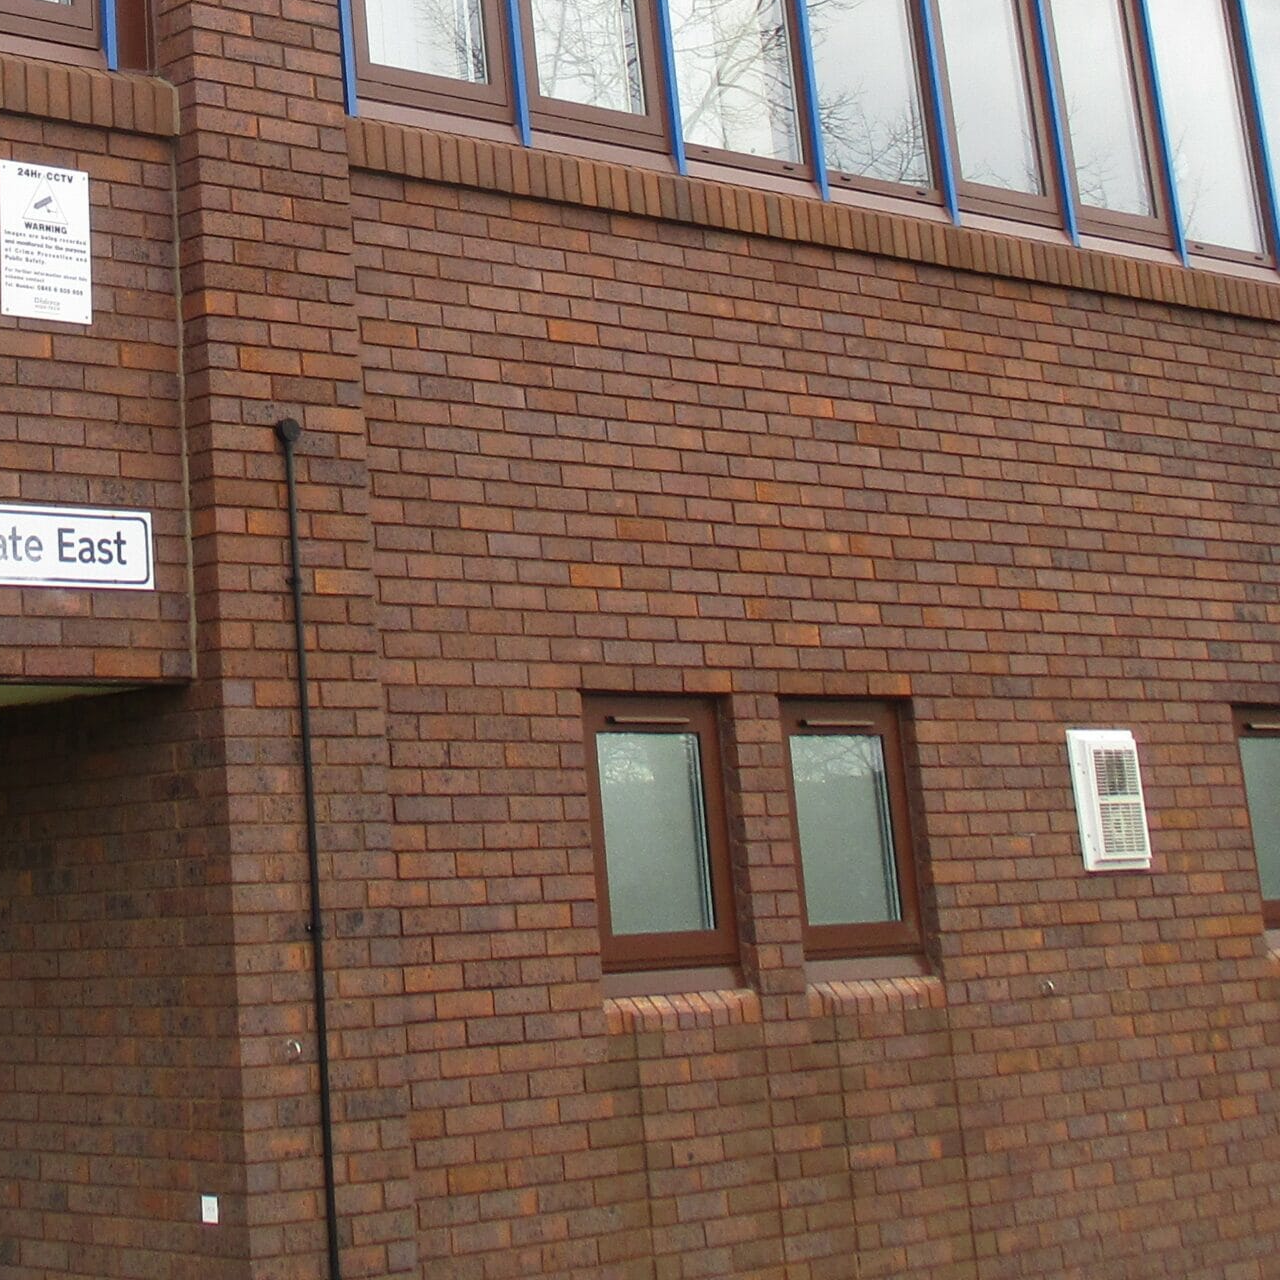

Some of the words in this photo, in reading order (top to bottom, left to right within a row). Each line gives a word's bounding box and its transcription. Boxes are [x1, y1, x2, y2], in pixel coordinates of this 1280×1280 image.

[17, 167, 42, 180] 24Hr
[46, 172, 74, 184] CCTV
[24, 221, 68, 235] WARNING
[14, 248, 35, 256] Crime
[37, 251, 73, 261] Prevention
[57, 527, 128, 566] East
